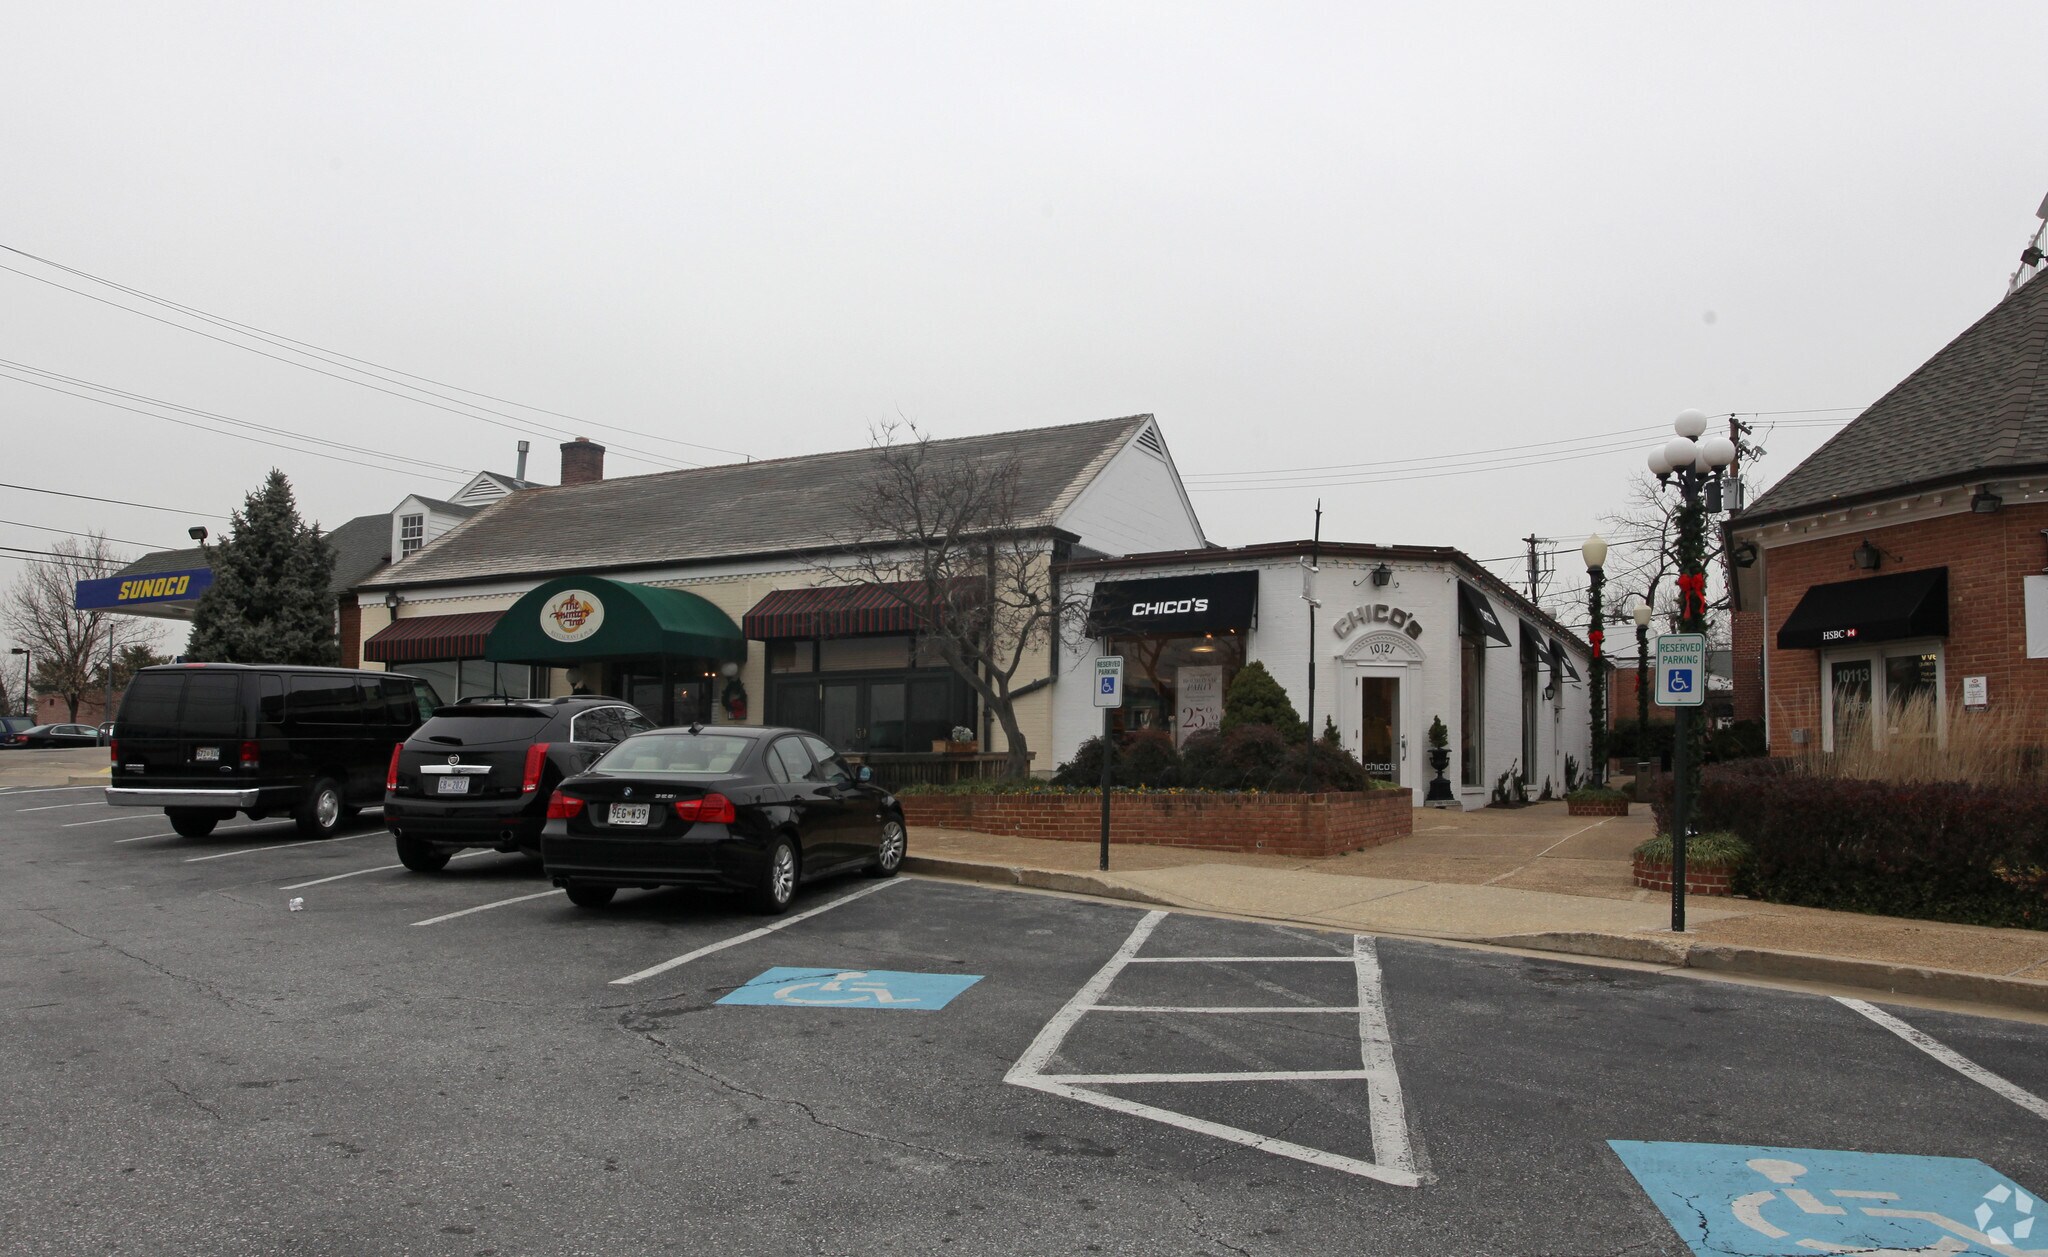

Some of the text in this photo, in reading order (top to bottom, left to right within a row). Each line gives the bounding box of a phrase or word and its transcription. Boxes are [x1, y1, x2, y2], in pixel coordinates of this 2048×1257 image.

[118, 575, 190, 600] SUNOCO
[561, 594, 579, 611] The
[1132, 598, 1208, 616] CHICO'S
[1333, 604, 1423, 640] CHICO'S
[1823, 629, 1845, 640] HSBC
[1370, 644, 1395, 655] 10121
[1660, 643, 1701, 652] RESERVED
[1662, 655, 1698, 664] PARKING
[1838, 668, 1869, 682] 10113
[1182, 706, 1218, 728] 25%
[1365, 762, 1396, 770] chico's
